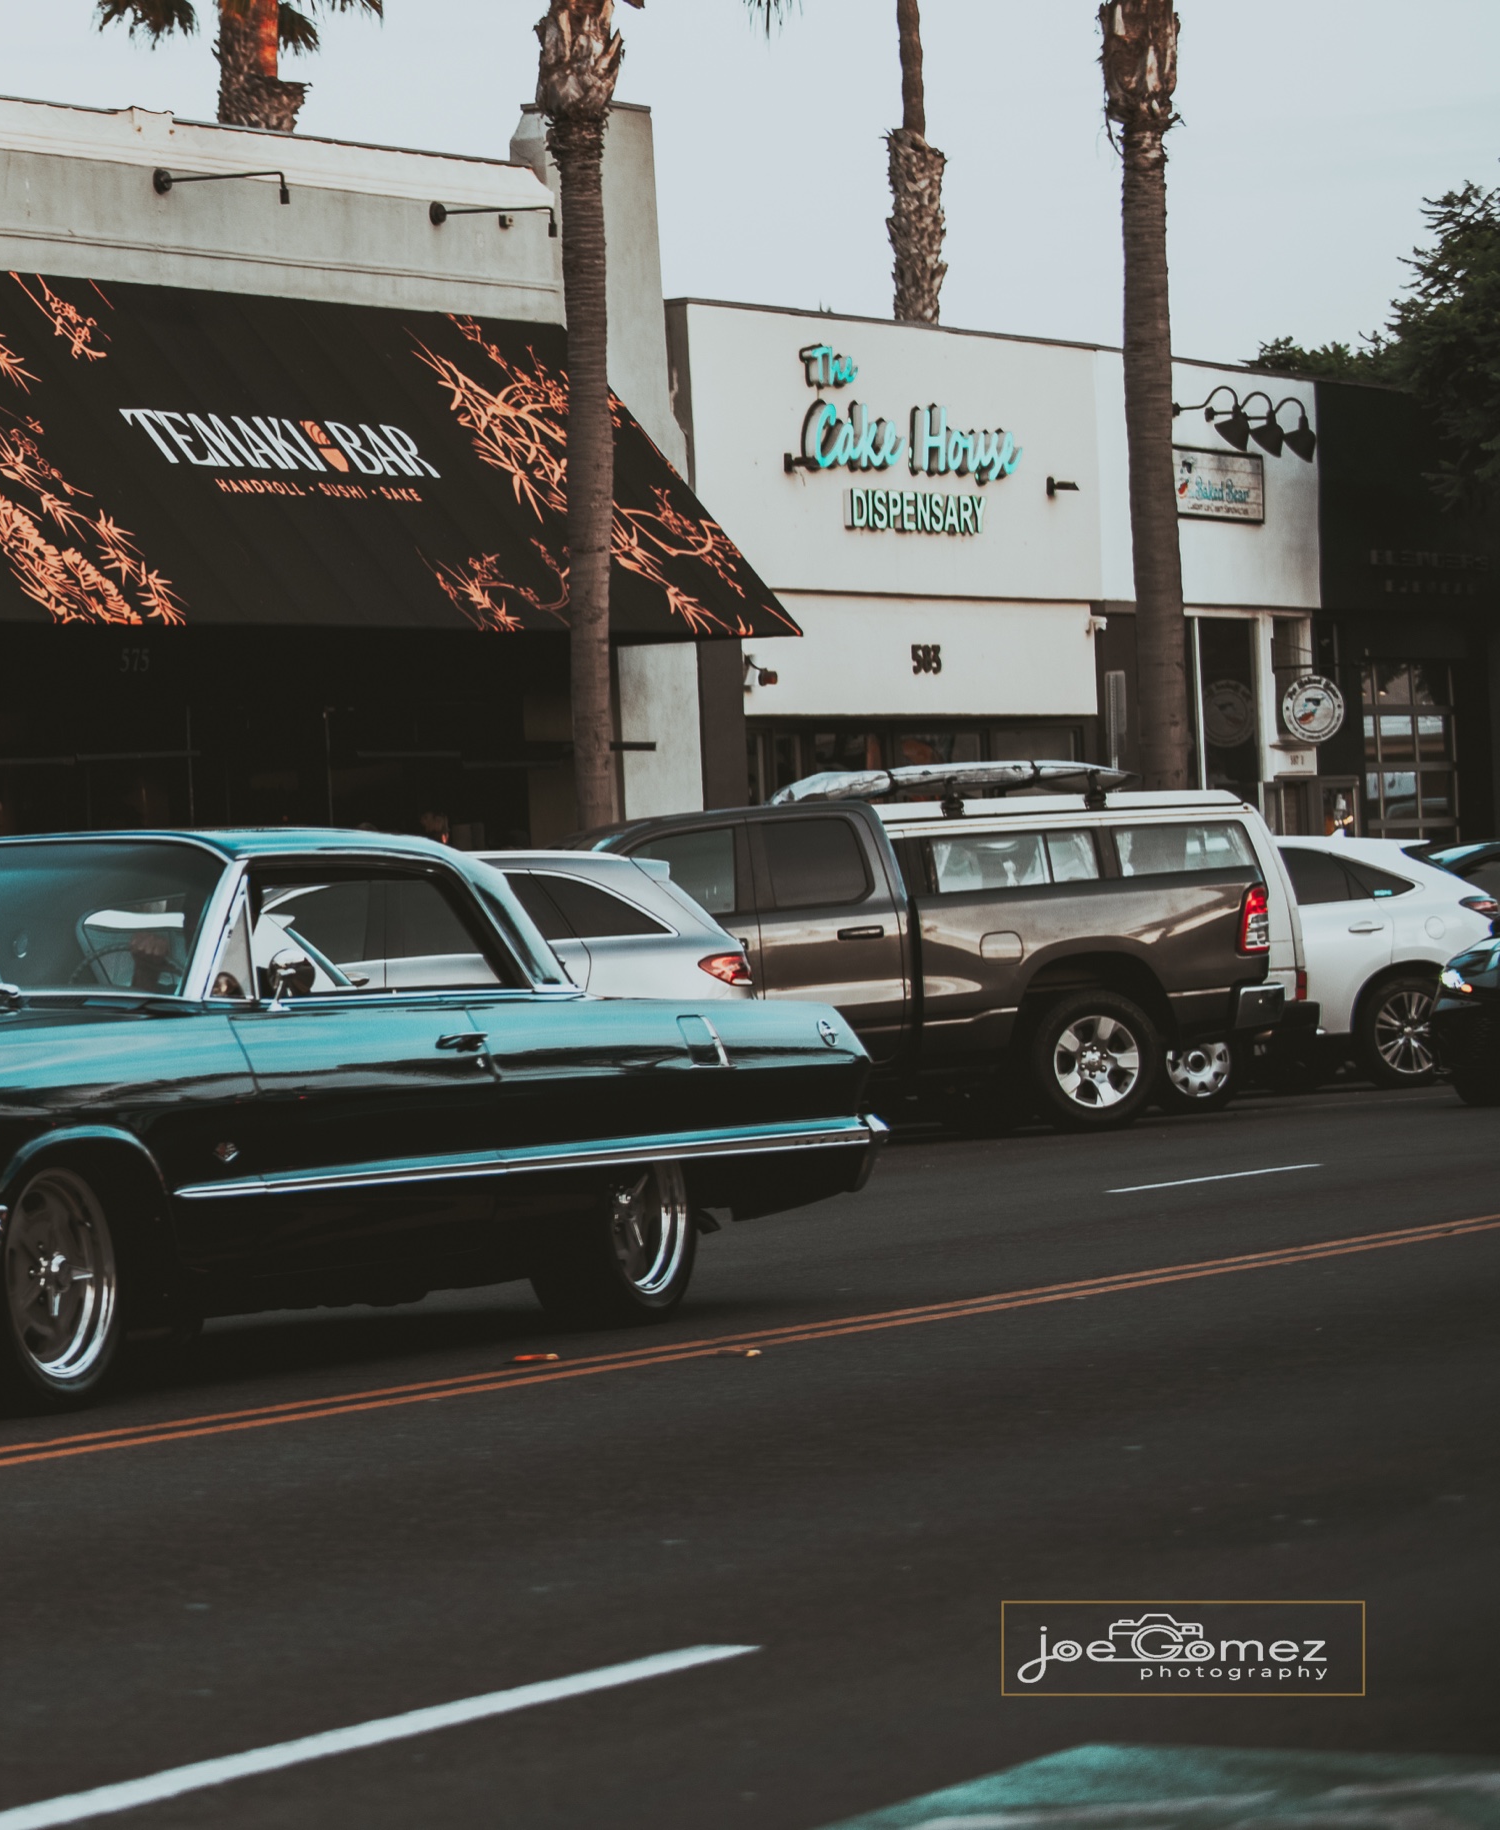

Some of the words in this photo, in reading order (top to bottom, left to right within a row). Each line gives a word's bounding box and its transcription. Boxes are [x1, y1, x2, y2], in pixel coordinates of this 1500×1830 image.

[801, 344, 858, 387] The
[118, 408, 327, 472] TEMAKI
[324, 420, 441, 478] BAR
[804, 400, 906, 471] Cake
[911, 403, 1023, 485] House
[214, 478, 306, 496] HANDROLL
[318, 482, 368, 499] SUSHI
[379, 486, 422, 502] SAKE
[849, 488, 987, 536] DISPENSARY
[119, 648, 150, 673] 575
